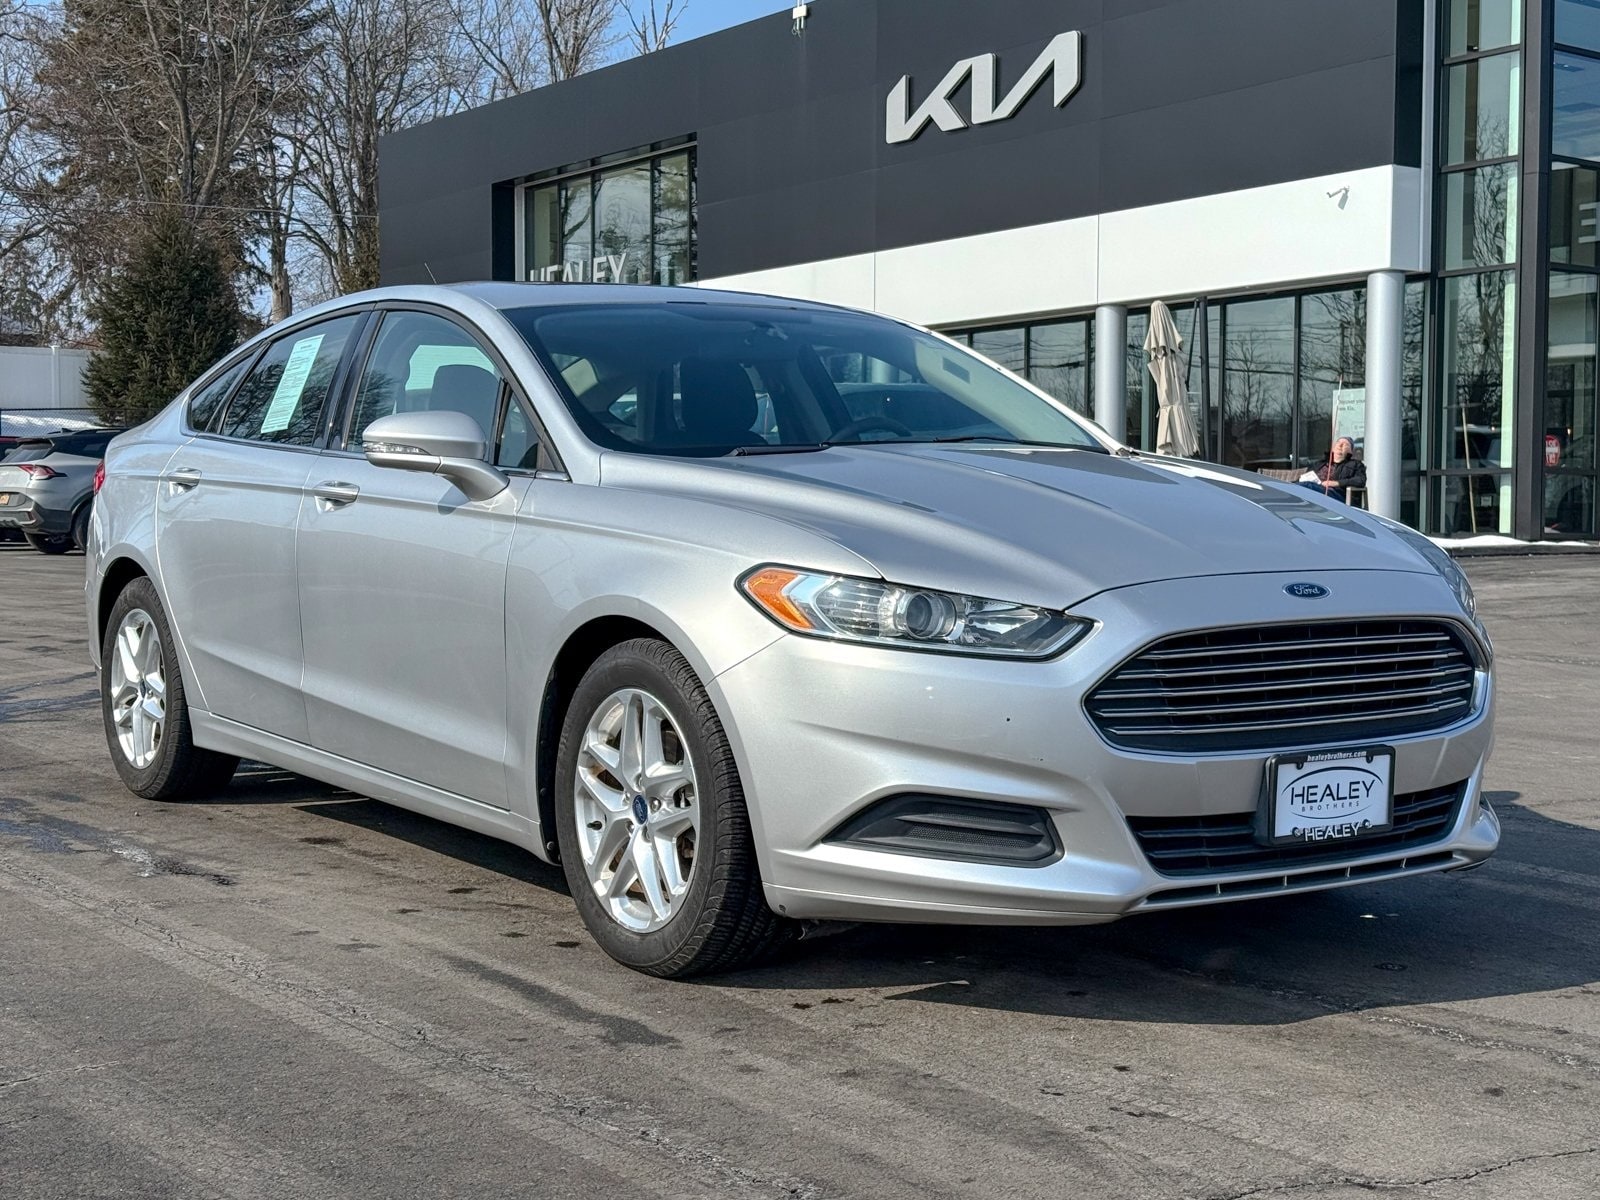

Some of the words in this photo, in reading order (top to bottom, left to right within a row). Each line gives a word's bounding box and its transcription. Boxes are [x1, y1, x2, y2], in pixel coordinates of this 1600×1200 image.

[886, 30, 1081, 144] KIA
[1293, 584, 1320, 595] Ford
[1306, 750, 1367, 762] healeybrothers.com
[1290, 779, 1376, 806] HEALEY
[1301, 800, 1360, 813] BROTHERS
[1303, 821, 1361, 842] HEALEY
